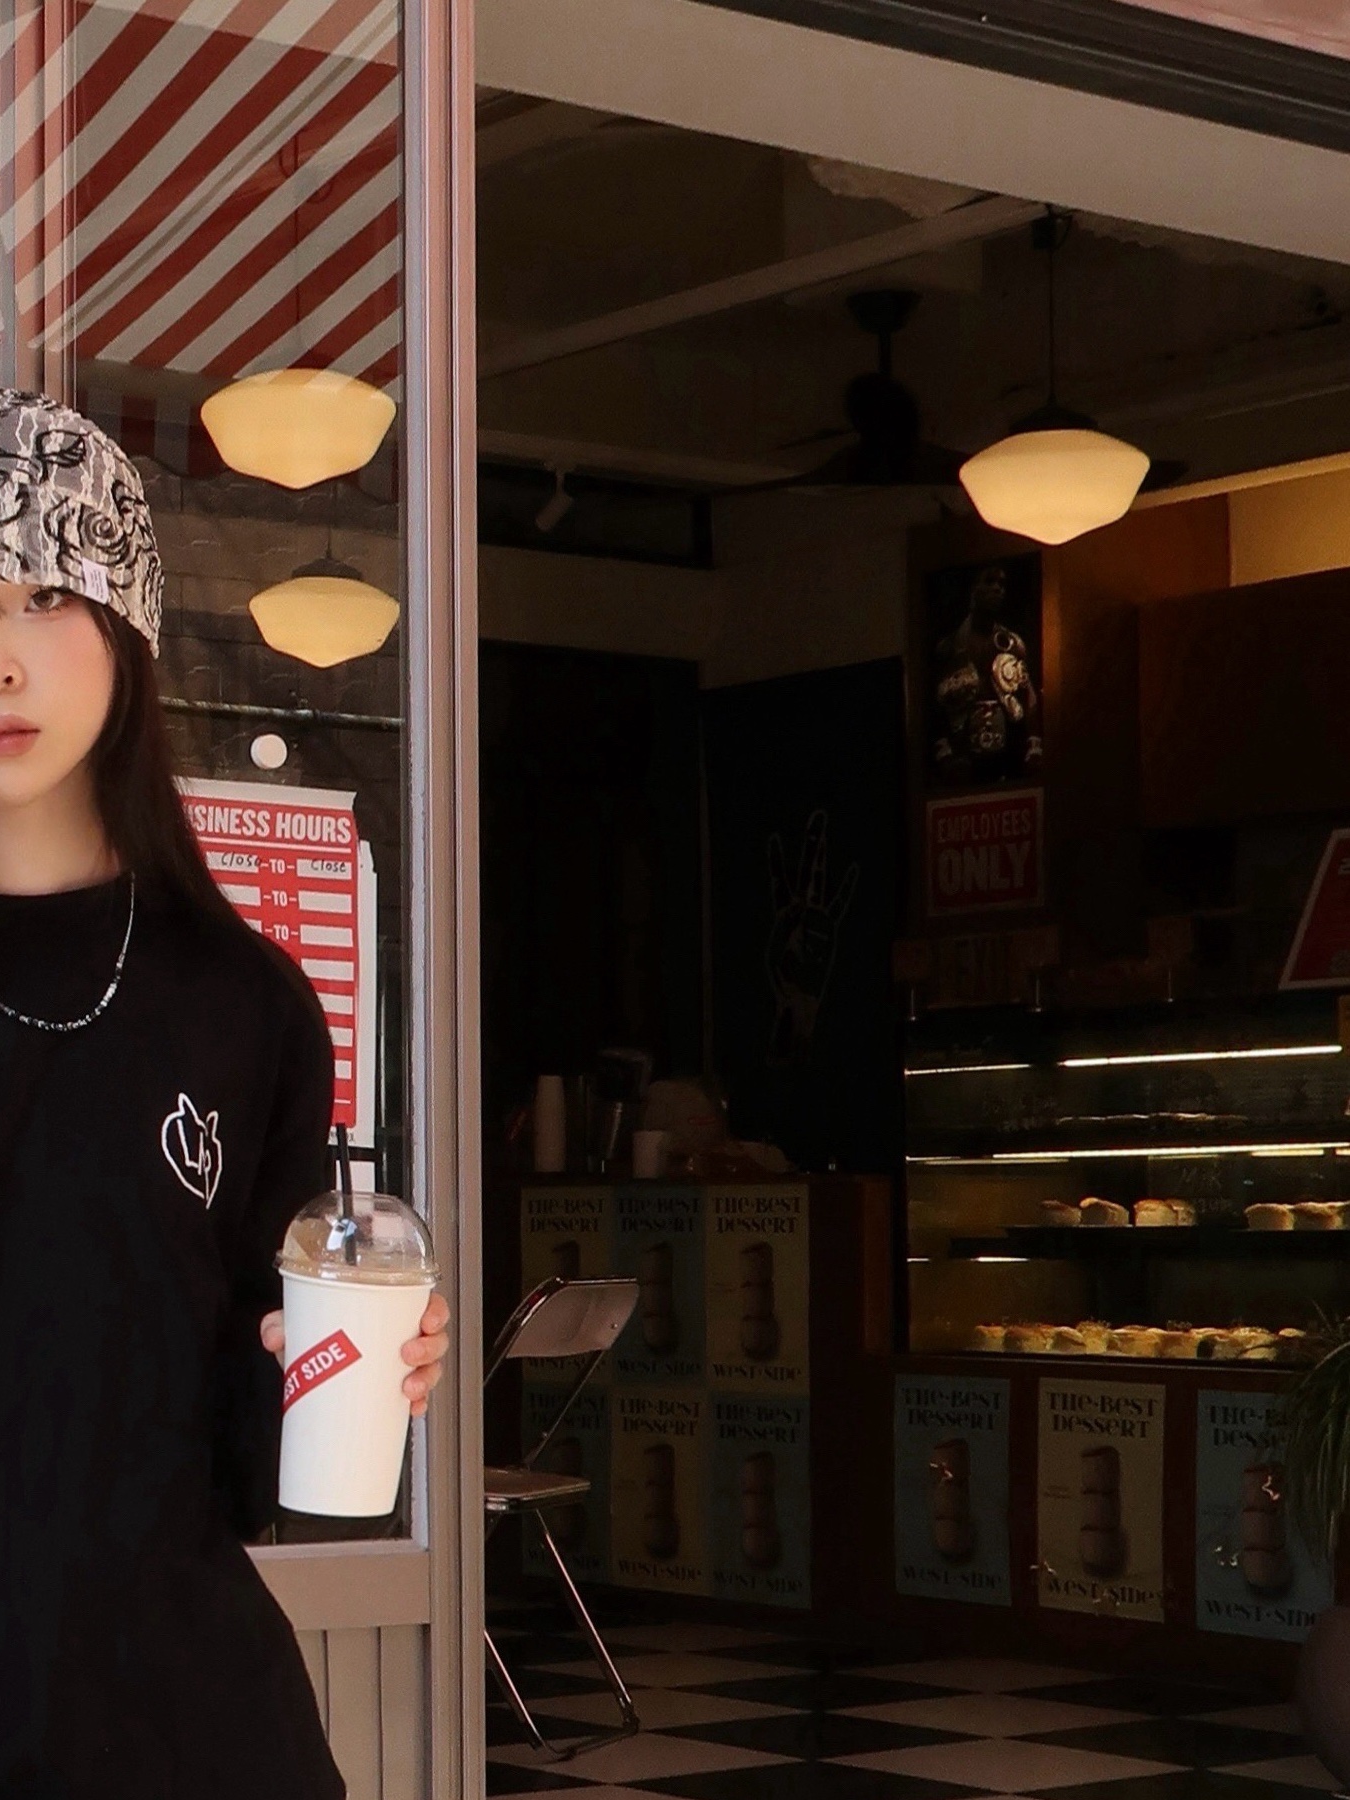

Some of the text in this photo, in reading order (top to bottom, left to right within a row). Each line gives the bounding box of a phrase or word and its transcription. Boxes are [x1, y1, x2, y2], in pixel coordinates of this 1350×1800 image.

[184, 803, 352, 844] SINESS HOURS
[936, 808, 1032, 843] EMPLOYEES
[310, 859, 347, 873] Close
[936, 840, 1032, 895] ONLY
[284, 1341, 347, 1405] EST SIDE
